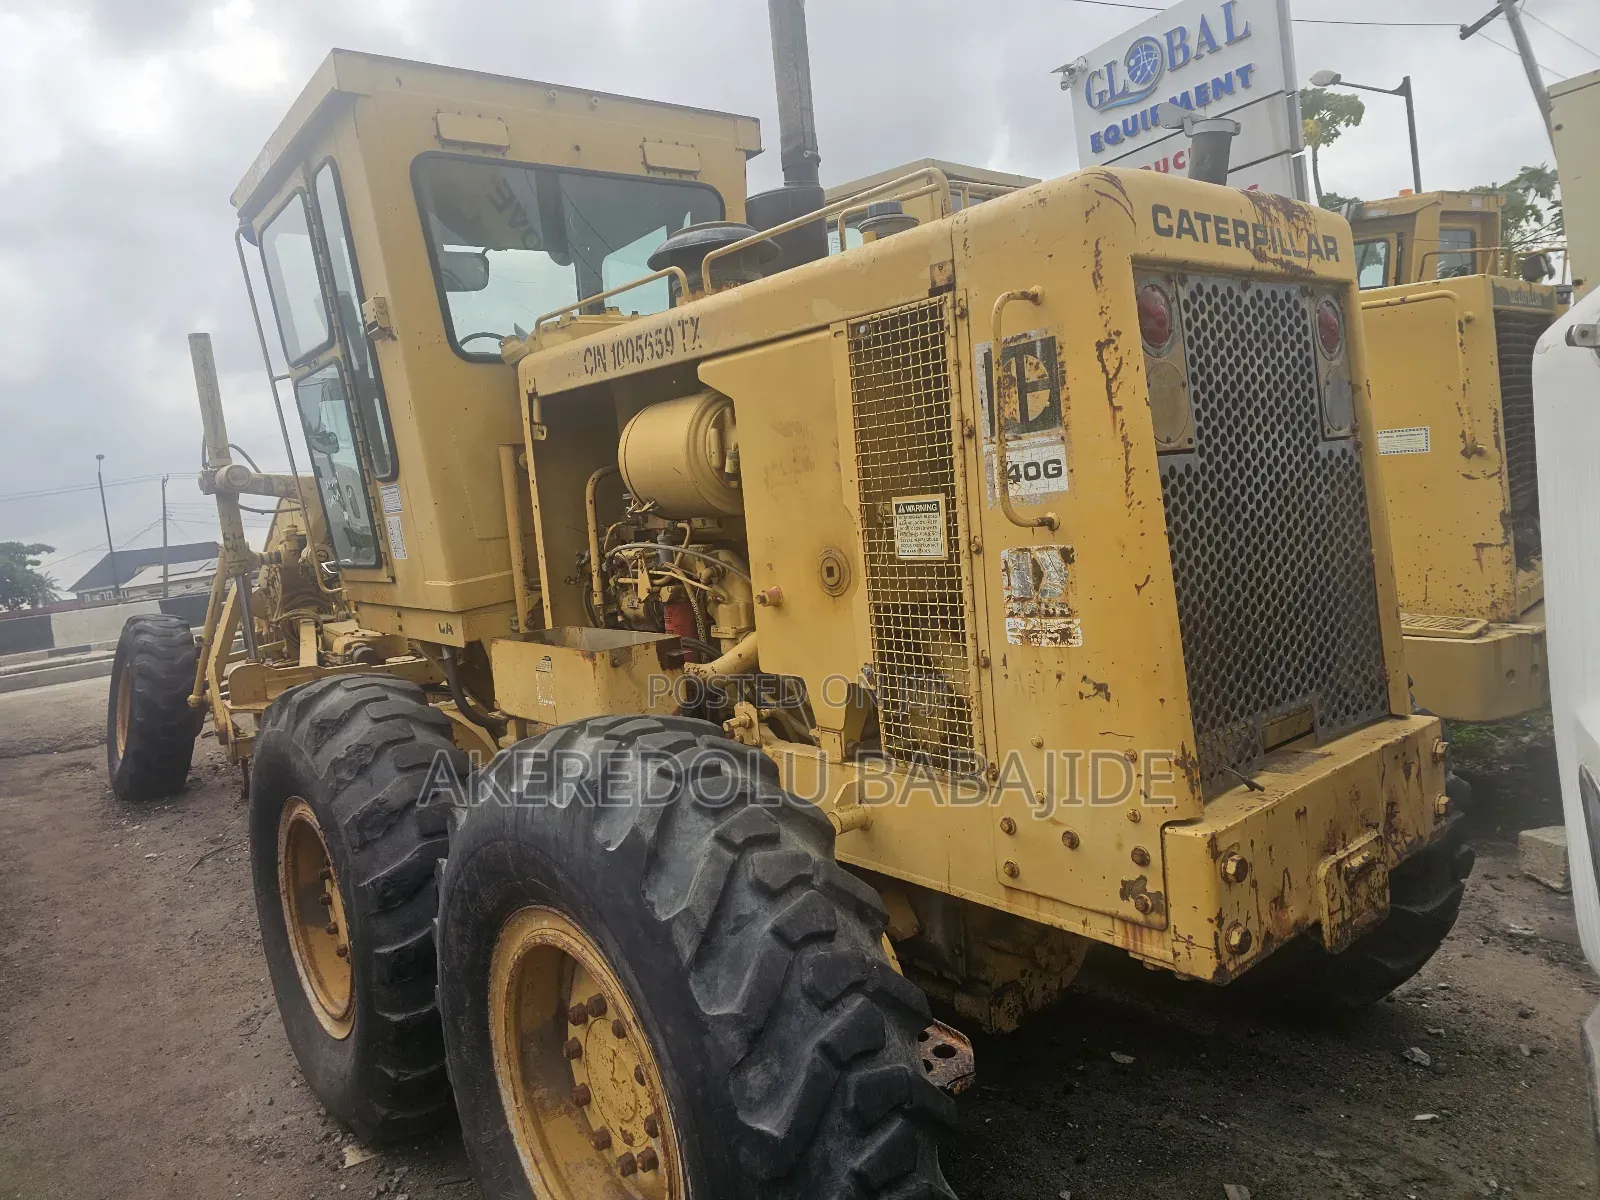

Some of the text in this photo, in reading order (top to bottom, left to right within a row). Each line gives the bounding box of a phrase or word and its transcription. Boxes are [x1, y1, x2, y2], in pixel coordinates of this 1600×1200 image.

[1084, 0, 1251, 110] GLOBAL
[1151, 203, 1340, 262] CATERPILLAR
[583, 343, 608, 376] CIN
[1006, 458, 1063, 484] 40G
[905, 503, 938, 513] WARNING
